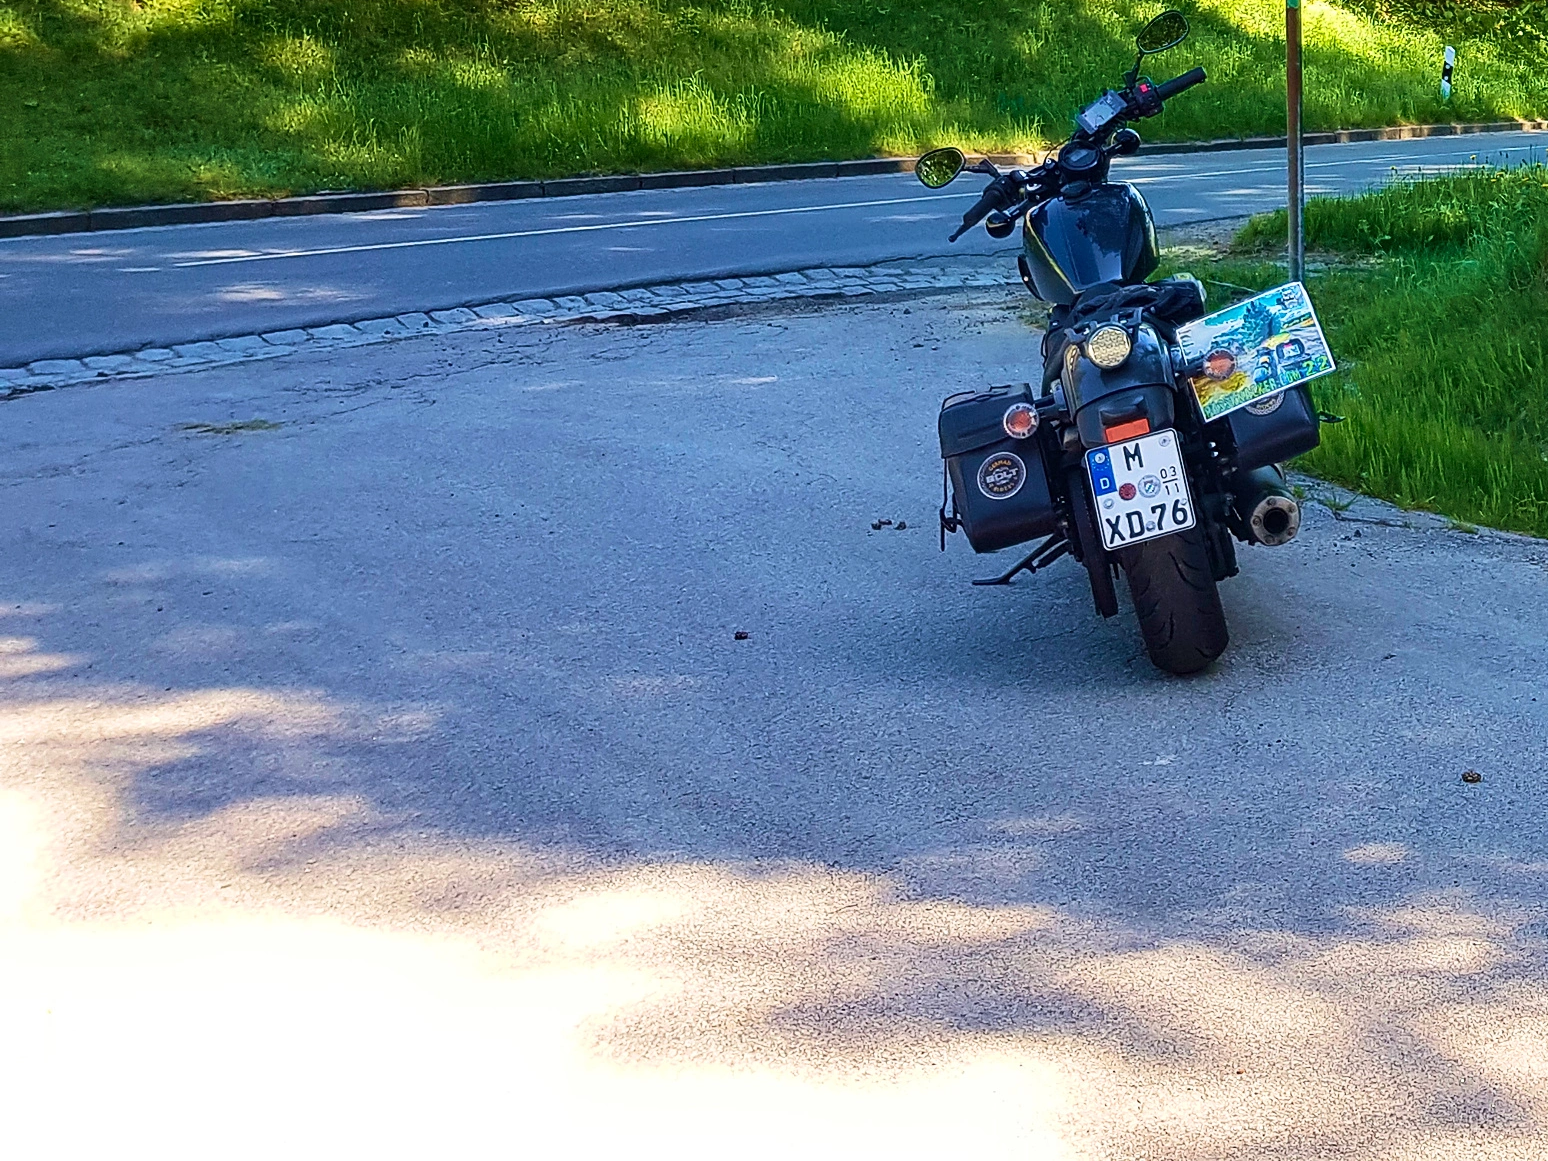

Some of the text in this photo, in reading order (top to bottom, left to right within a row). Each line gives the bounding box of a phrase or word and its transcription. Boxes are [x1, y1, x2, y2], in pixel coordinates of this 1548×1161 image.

[1122, 442, 1144, 472] M
[985, 467, 1018, 484] BOLT
[1160, 465, 1177, 479] 03
[1100, 477, 1110, 490] D
[1165, 482, 1180, 496] 11
[1150, 498, 1189, 531] 76
